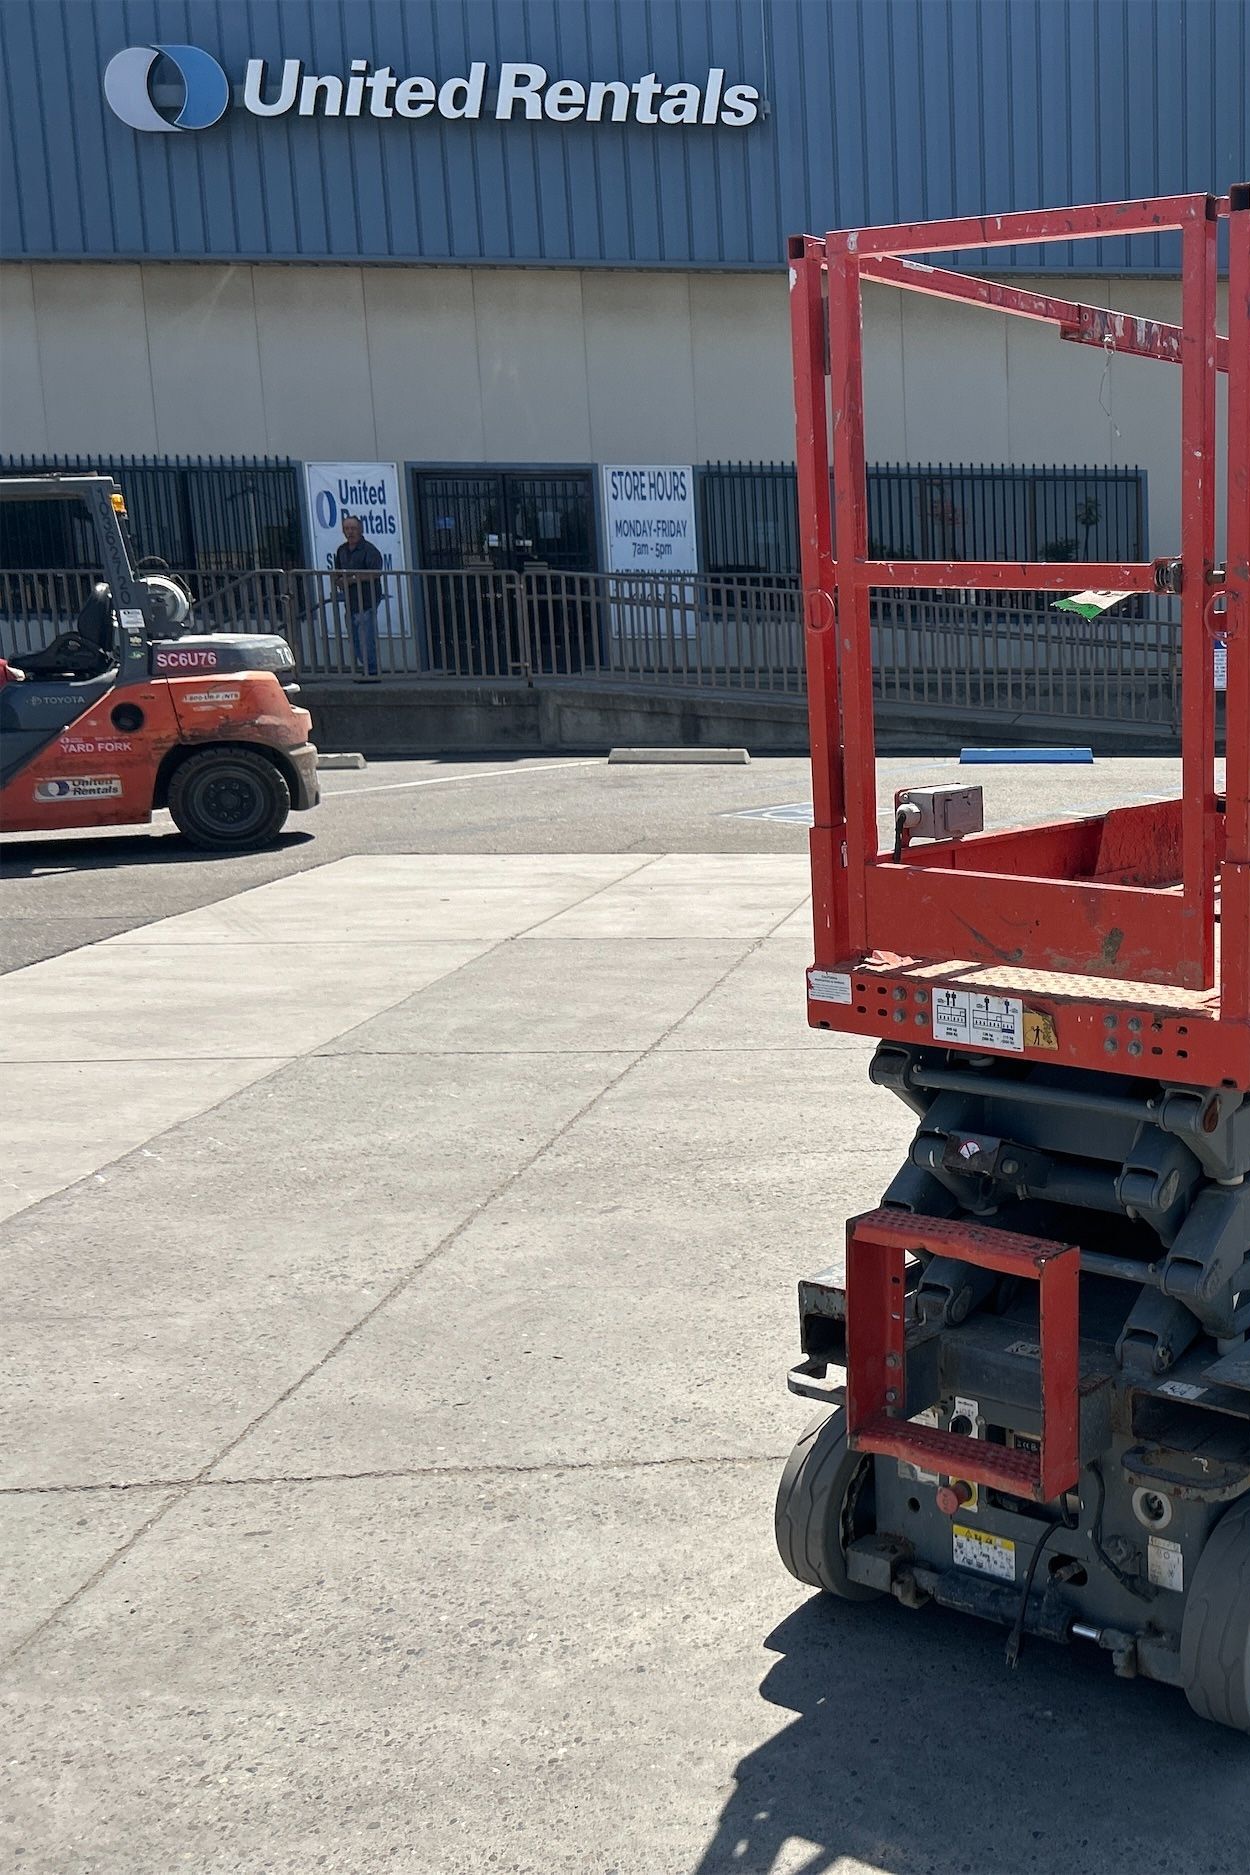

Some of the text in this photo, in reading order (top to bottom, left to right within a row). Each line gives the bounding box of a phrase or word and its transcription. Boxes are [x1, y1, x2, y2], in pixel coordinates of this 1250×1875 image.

[243, 59, 760, 128] United Rentals
[339, 479, 386, 505] United
[611, 471, 687, 501] STORE HOURS
[341, 508, 396, 534] Rntals
[615, 520, 687, 538] MONDAY-FRIDAY
[632, 542, 649, 558] 7am
[655, 543, 673, 559] 5pm
[157, 652, 217, 668] SC6U76
[44, 696, 85, 704] TOYOTA
[60, 742, 132, 753] YARD FORK
[72, 785, 119, 796] Rentals
